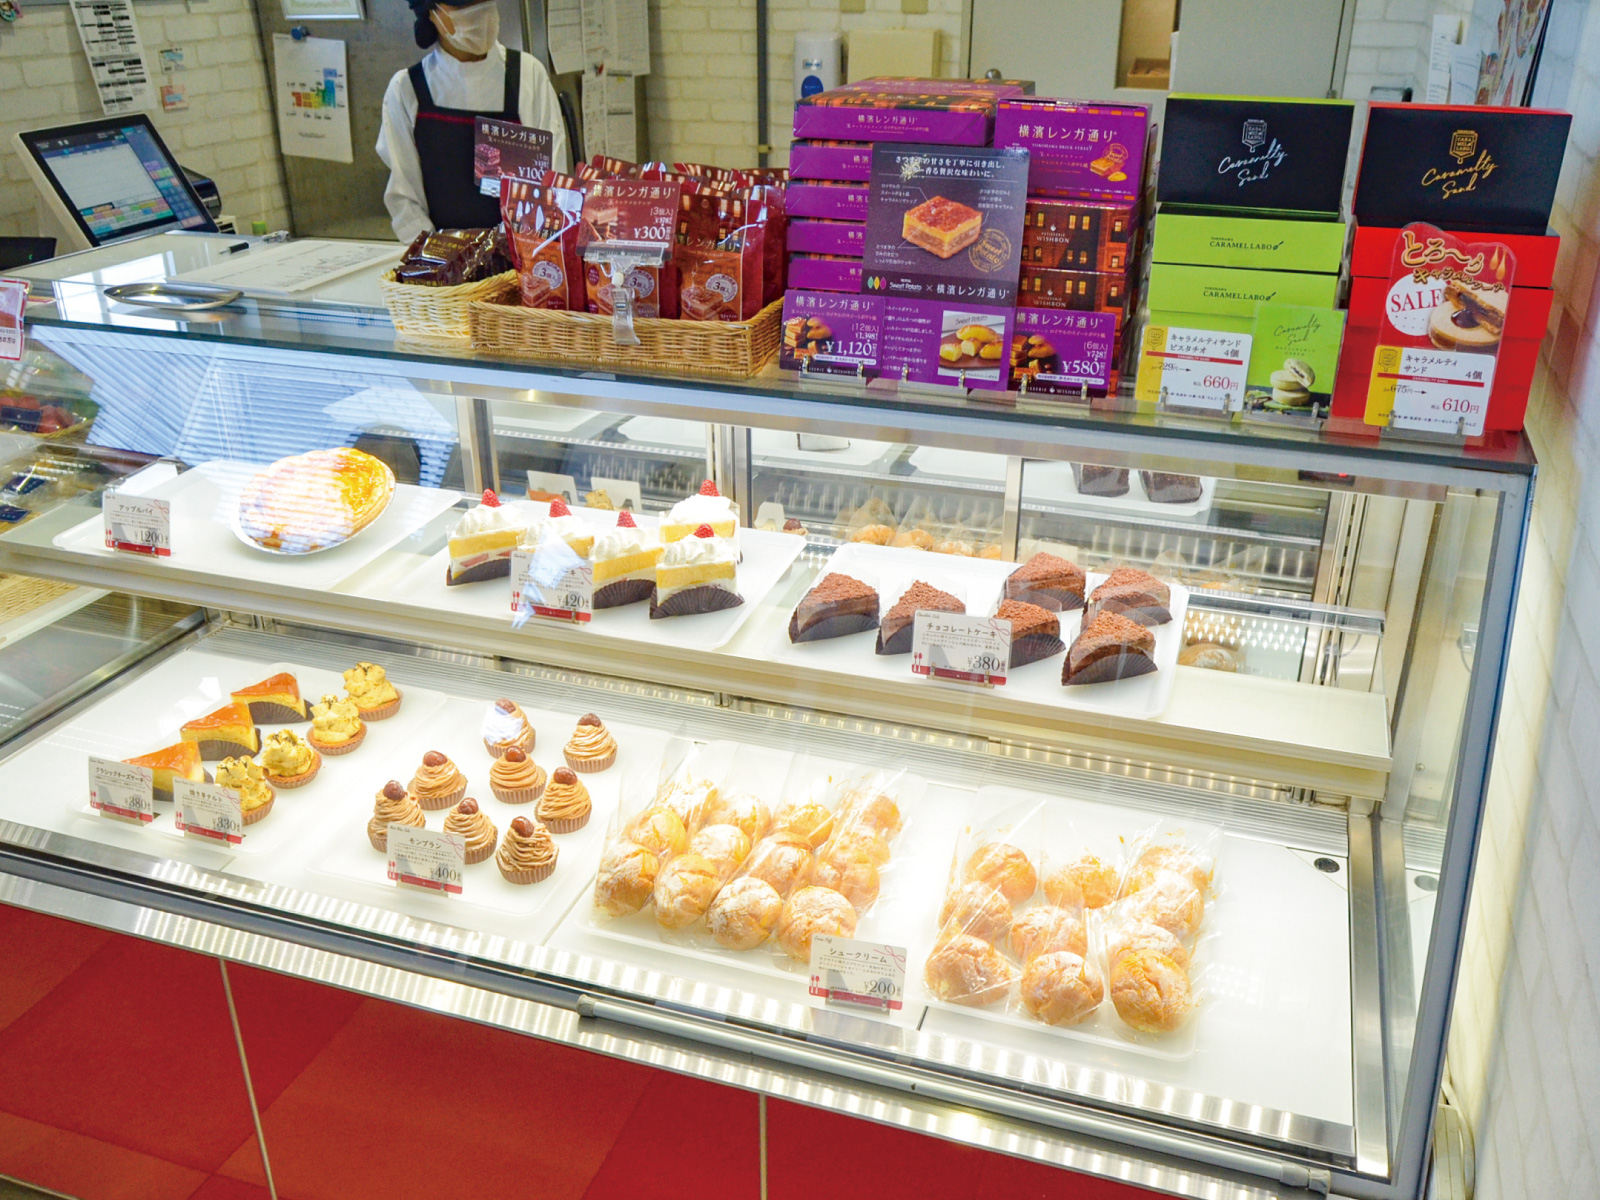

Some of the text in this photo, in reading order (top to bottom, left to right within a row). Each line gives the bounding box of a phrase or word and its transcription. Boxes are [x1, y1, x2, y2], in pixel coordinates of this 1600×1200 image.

[1019, 124, 1114, 142] 横濱レンガ通り
[593, 184, 672, 199] 横濱レンガ通り
[634, 226, 666, 240] ¥300
[1209, 241, 1249, 249] CARAMEL
[937, 284, 1006, 300] 横濱レンガ通り
[1203, 291, 1265, 301] CARAMEL LABO
[796, 296, 870, 311] 横濱レンガ通り
[1017, 312, 1099, 329] 横濱レンガ通り
[826, 341, 872, 356] ¥1,120
[1171, 334, 1242, 348] キャラメルティサンド
[1170, 344, 1240, 358] ピスタチオ 4個
[1062, 360, 1100, 375] ¥580
[1405, 354, 1457, 367] キャラメルティ
[1404, 365, 1482, 380] サンド 4個
[1203, 375, 1239, 391] 660円
[1442, 398, 1479, 414] 610円
[558, 593, 585, 608] ¥420
[927, 622, 997, 638] チョコレートケーキ
[968, 654, 1000, 671] ¥380
[409, 837, 441, 849] モンブラン
[430, 866, 457, 881] ¥400
[829, 948, 887, 963] シュークリーム
[864, 979, 896, 995] ¥200
